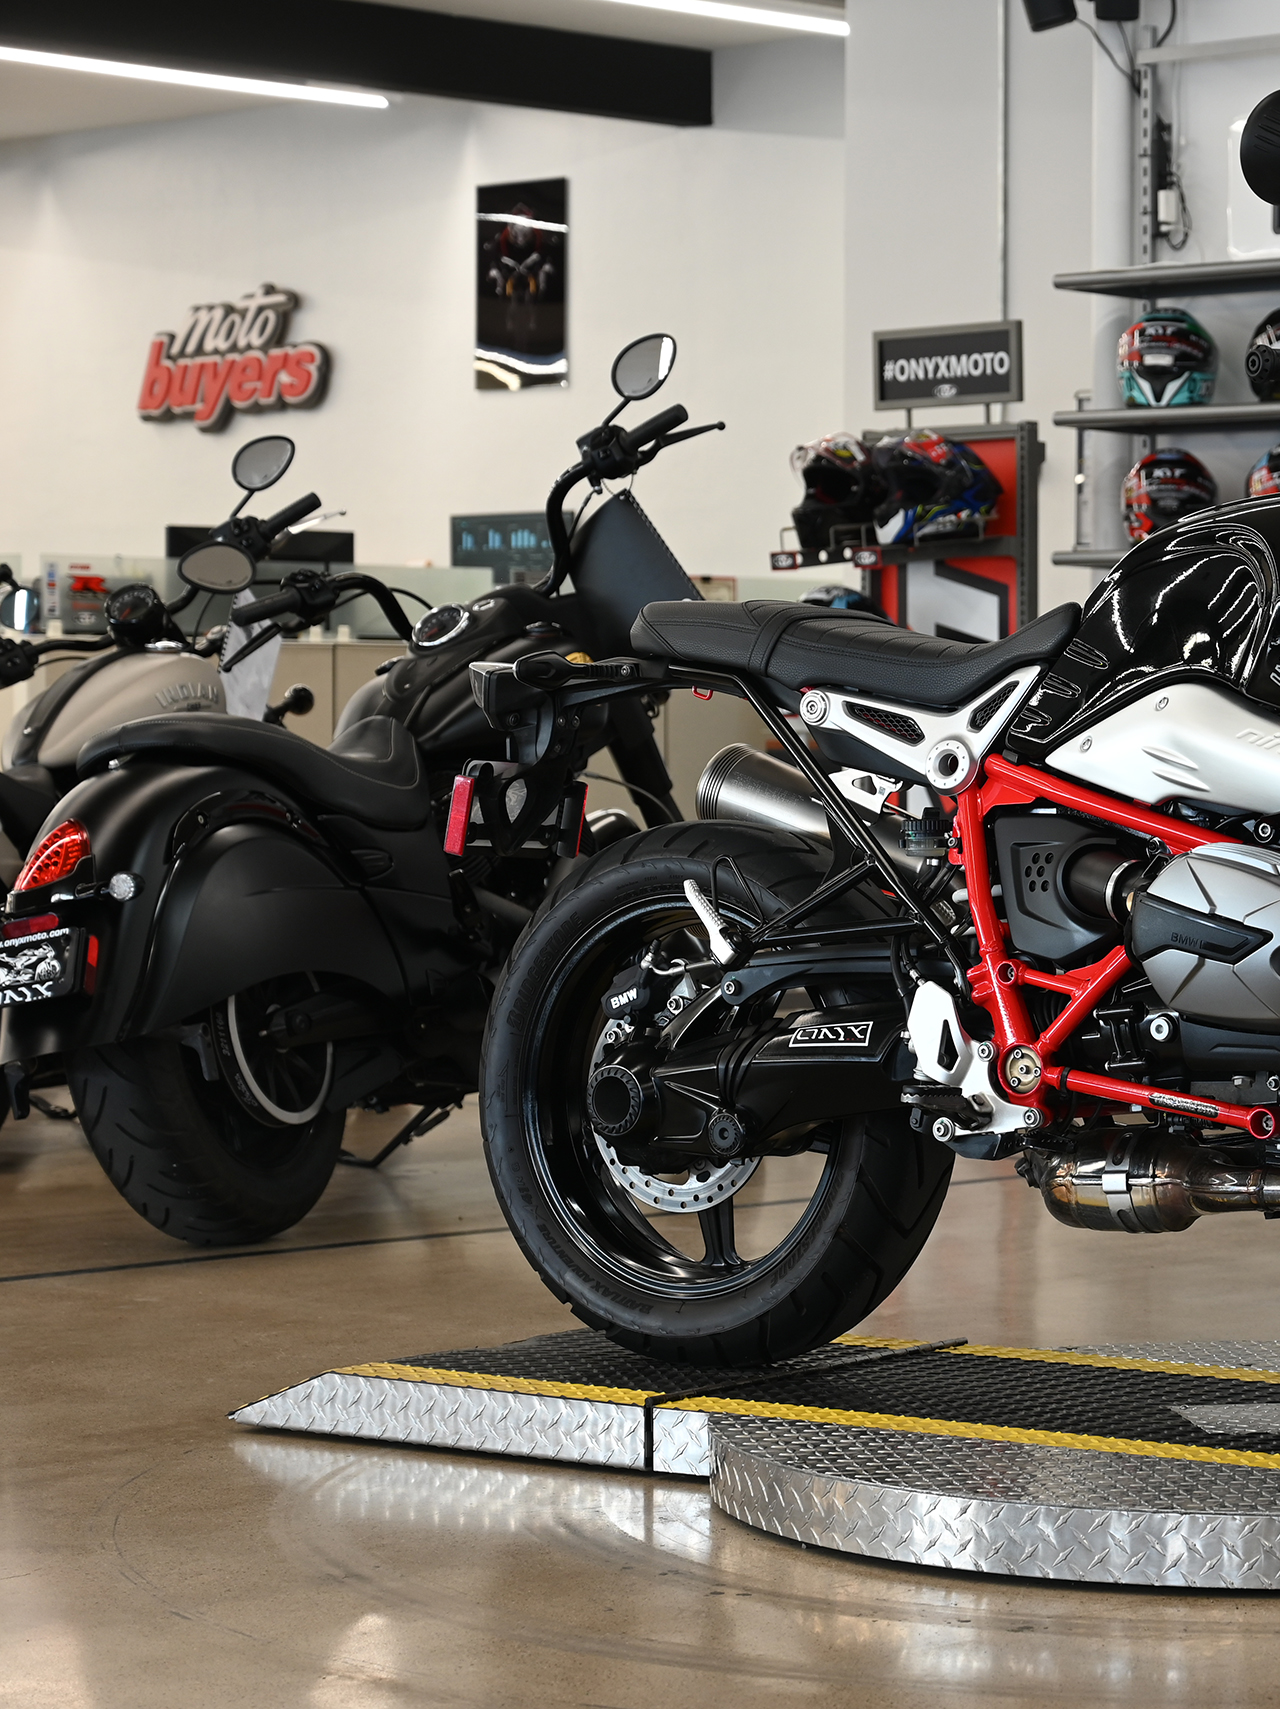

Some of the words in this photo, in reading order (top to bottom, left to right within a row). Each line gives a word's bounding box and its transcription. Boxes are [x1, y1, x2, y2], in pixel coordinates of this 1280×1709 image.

[138, 338, 317, 422] buyers
[883, 351, 1011, 383] #ONYXMOTO
[155, 682, 219, 708] INDIAN
[0, 927, 70, 948] .onyxmoto.com
[1171, 932, 1199, 947] BMW
[507, 911, 582, 1029] BRIDGESTONE
[610, 987, 637, 1009] BMW
